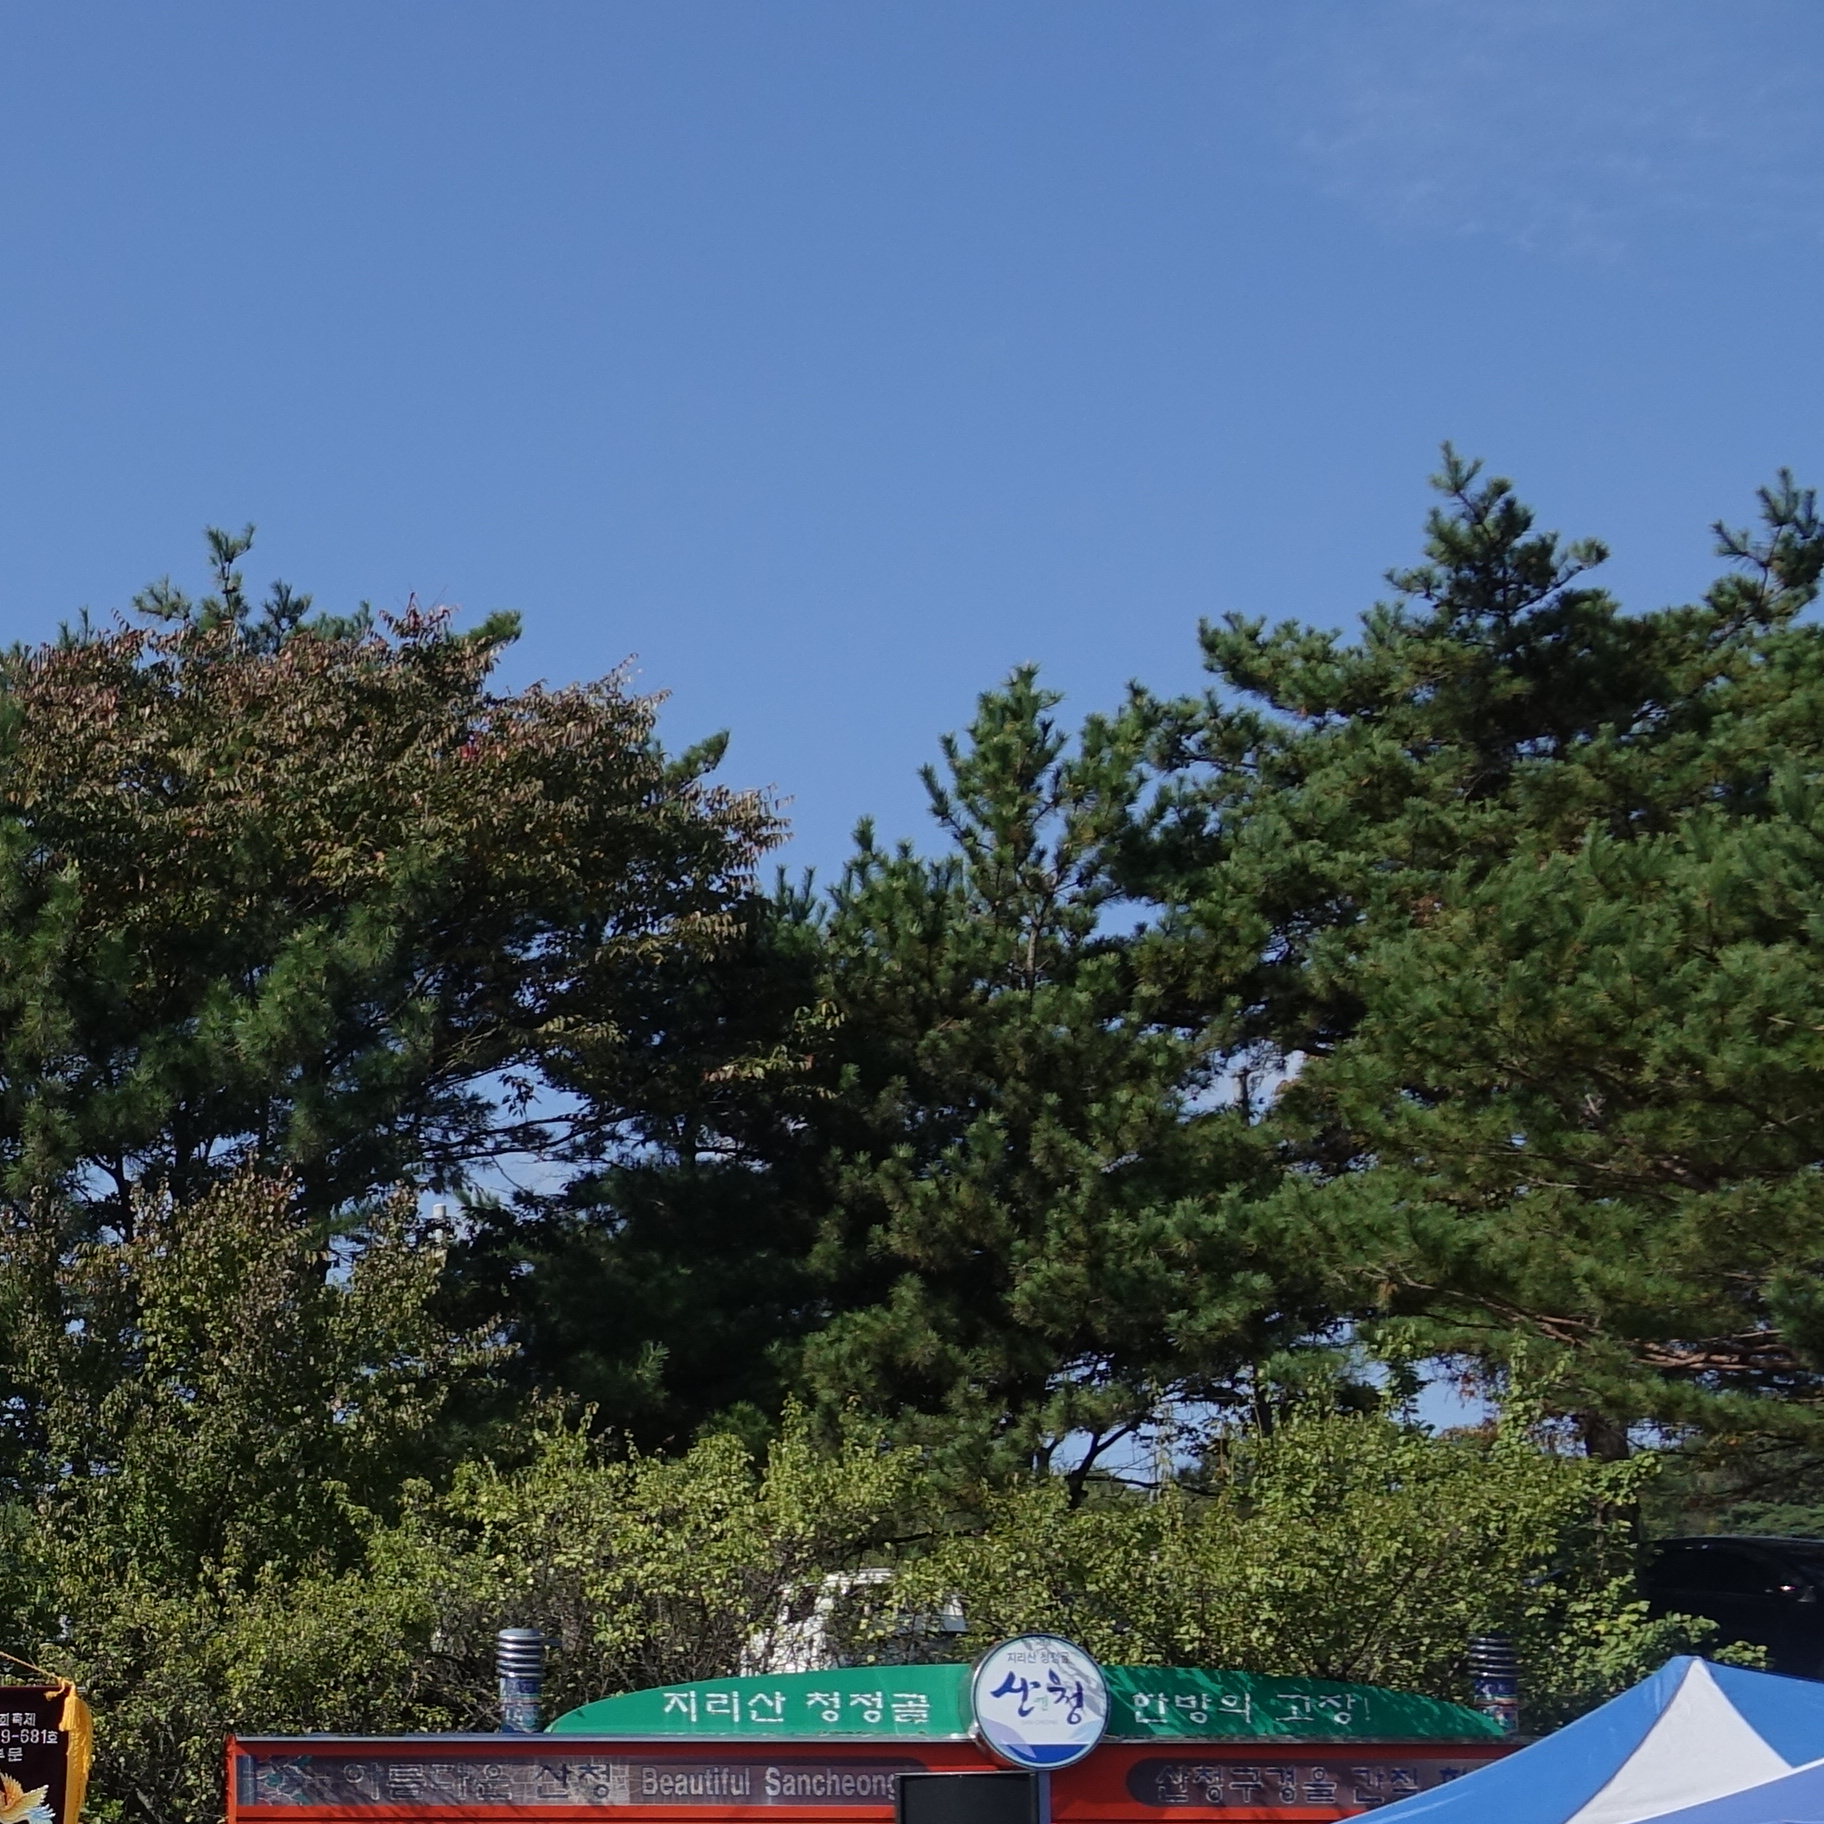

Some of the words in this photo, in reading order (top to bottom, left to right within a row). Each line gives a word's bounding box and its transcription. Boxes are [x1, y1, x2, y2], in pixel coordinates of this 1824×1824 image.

[1006, 1651, 1037, 1664] 지리산
[663, 1690, 787, 1723] 지리산
[805, 1690, 931, 1724] 청정골
[989, 1668, 1084, 1726] 산청
[1131, 1691, 1252, 1725] 한방의
[1274, 1691, 1372, 1726] 고장!
[342, 1761, 514, 1801] 아름다운
[534, 1760, 612, 1801] 산청
[640, 1766, 751, 1797] Beautiful
[764, 1765, 897, 1800] Sancheong
